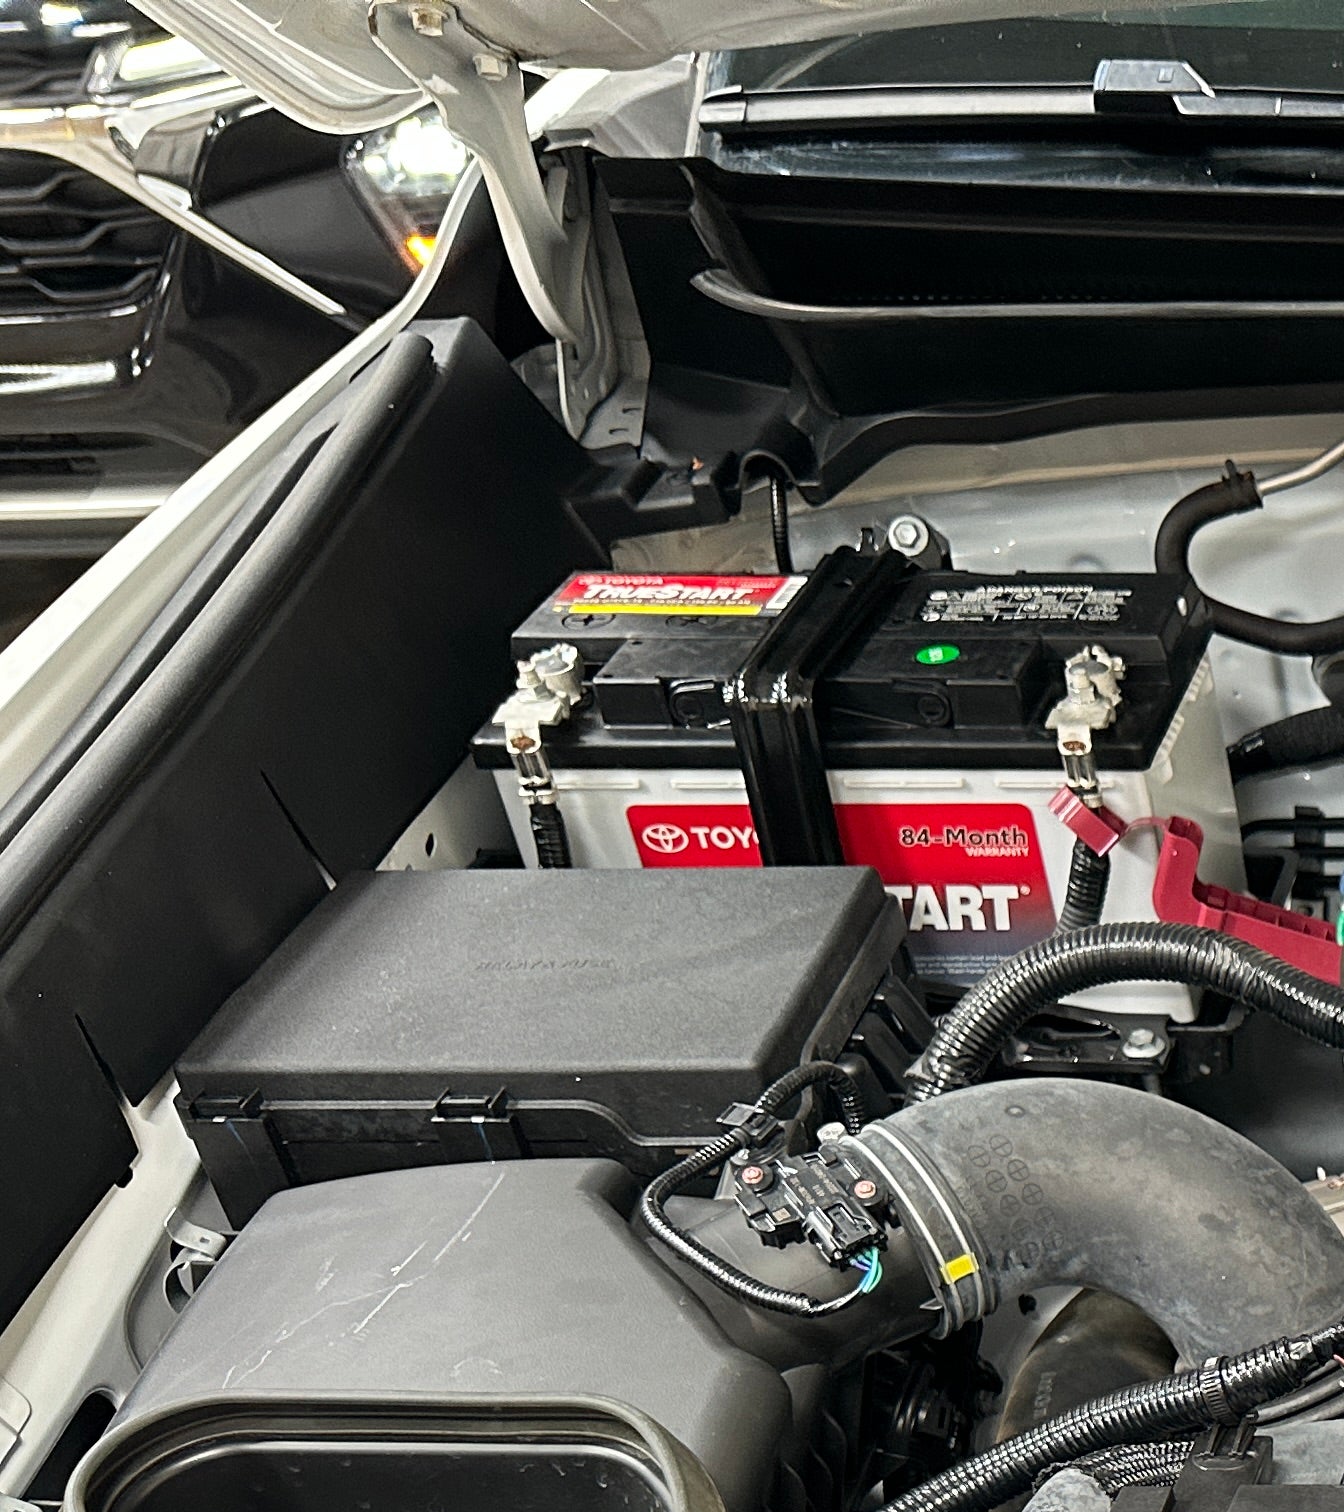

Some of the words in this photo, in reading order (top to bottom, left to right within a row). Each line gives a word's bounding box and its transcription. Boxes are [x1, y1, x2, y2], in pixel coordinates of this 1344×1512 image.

[583, 584, 754, 600] TRUESTART
[690, 825, 759, 849] TOY
[900, 825, 1028, 847] 84-Month
[965, 847, 1029, 857] WARRANTY
